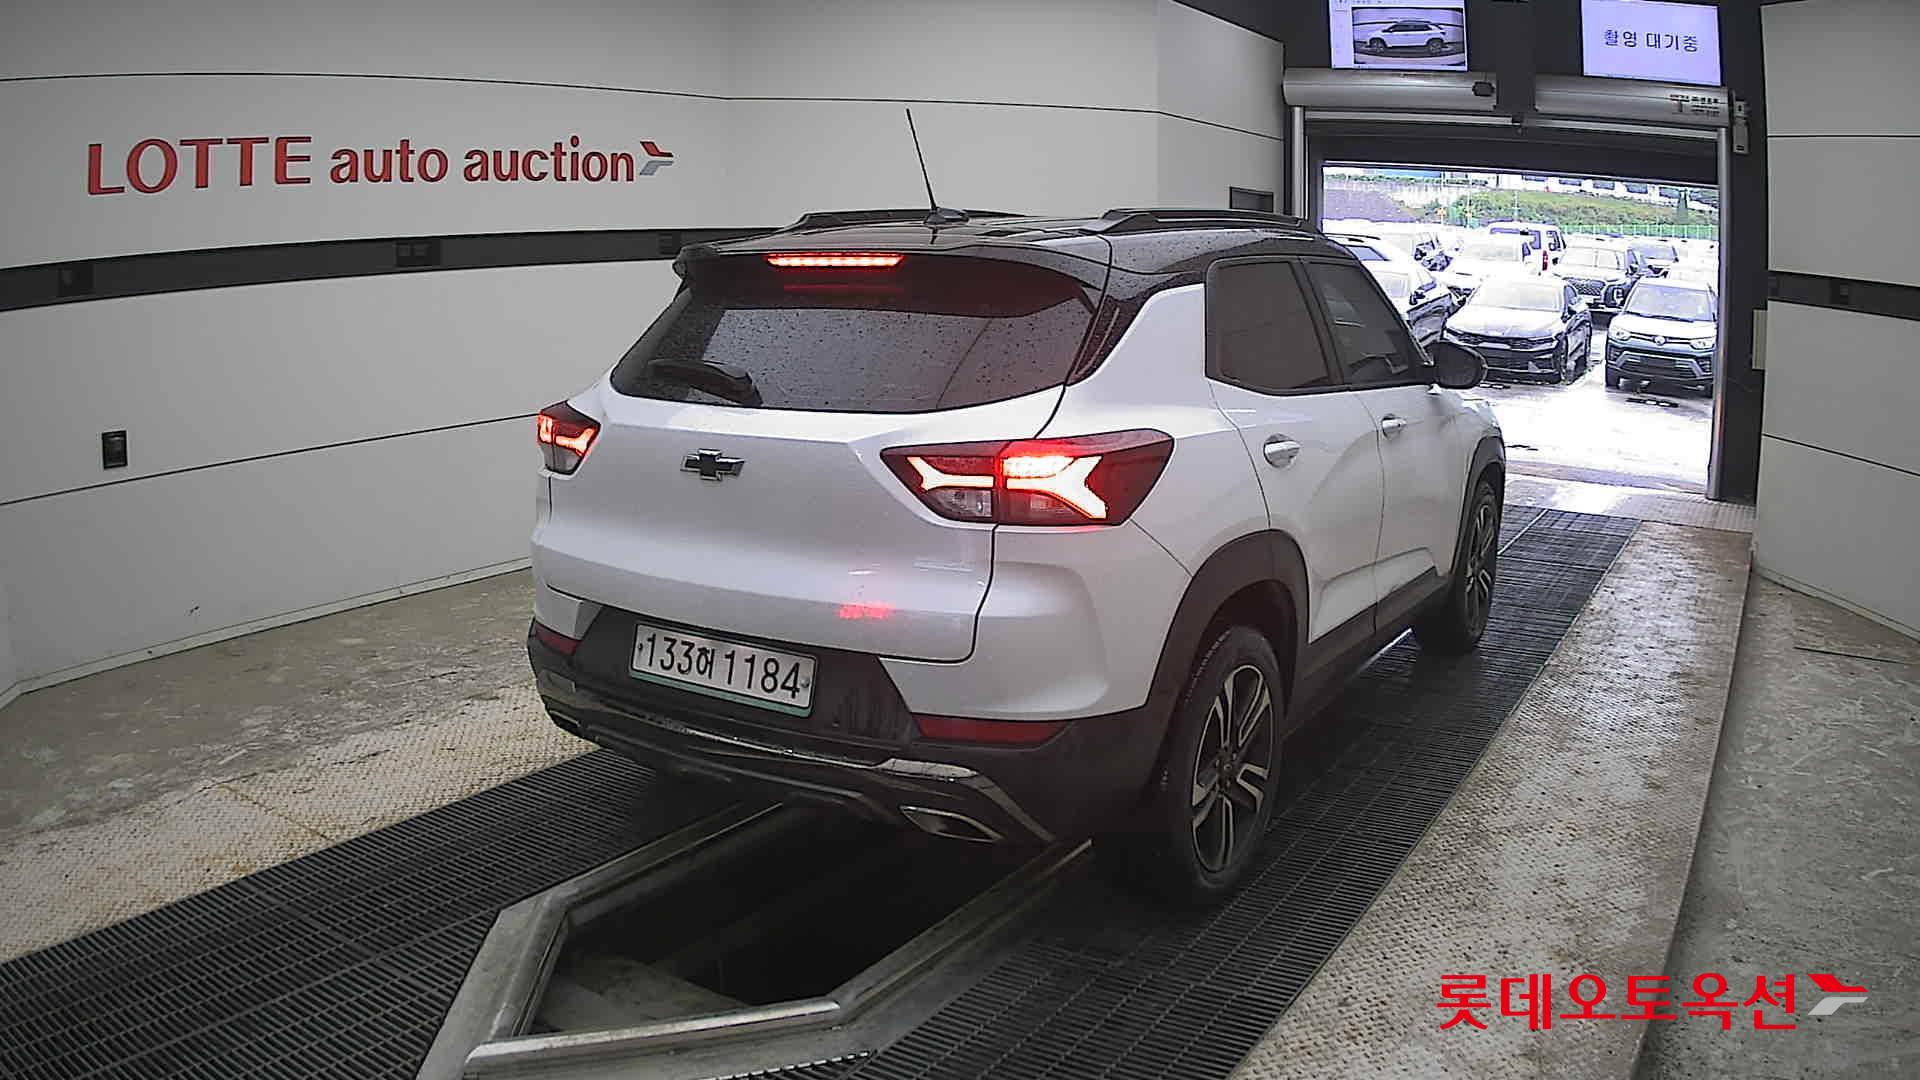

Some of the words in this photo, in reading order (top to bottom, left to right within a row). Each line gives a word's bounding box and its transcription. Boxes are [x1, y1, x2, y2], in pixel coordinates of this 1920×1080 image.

[1605, 29, 1637, 48] 촬영
[1646, 33, 1698, 53] 대기중
[87, 136, 312, 195] LOTTE
[329, 139, 448, 184] auto
[463, 135, 635, 184] auction
